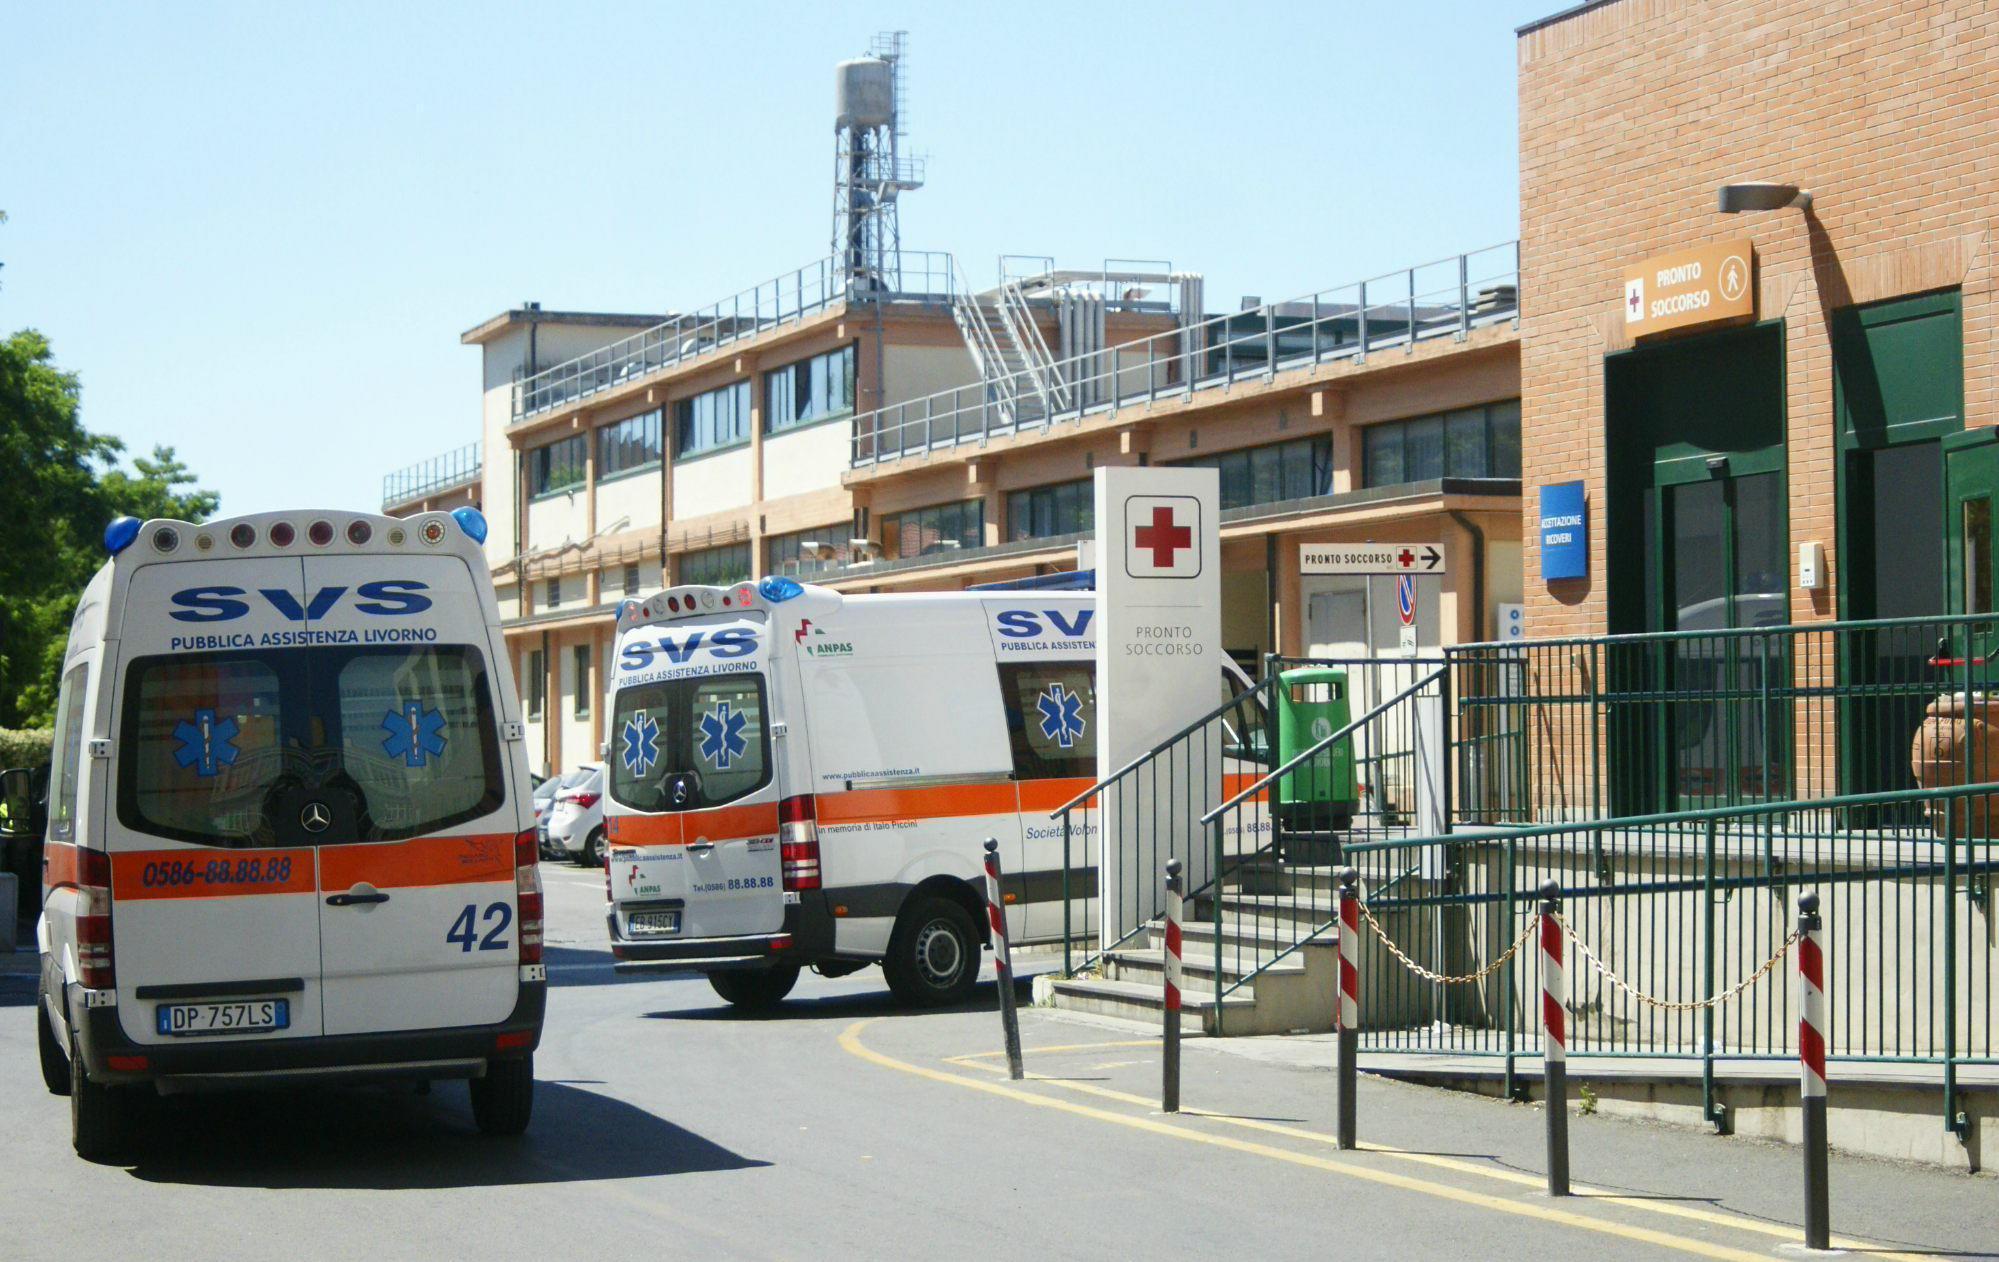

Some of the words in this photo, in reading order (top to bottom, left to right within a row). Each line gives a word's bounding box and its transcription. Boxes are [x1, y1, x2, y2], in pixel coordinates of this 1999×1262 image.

[1656, 262, 1702, 288] PRONTO
[1650, 289, 1710, 318] SOCCORSO
[1305, 553, 1341, 565] PRONTO
[1344, 553, 1393, 565] SOCCORSO
[169, 580, 433, 623] SVS
[171, 632, 255, 651] PUBBLICA
[260, 629, 359, 647] ASSISTENZA
[364, 627, 438, 643] LIVORNO
[1136, 626, 1192, 639] PRONTO
[620, 627, 759, 671] SVS
[817, 642, 853, 653] ANPAS
[1001, 642, 1049, 651] PUBBLICA
[1051, 640, 1096, 650] ASSISTEN
[1126, 643, 1203, 656] SOCCORSO
[619, 673, 655, 688] PUBBLICA
[656, 665, 710, 681] ASSISTENZA
[712, 660, 757, 674] LIVORNO
[822, 767, 920, 781] www.pubblicaassistenza.it
[828, 822, 863, 833] memoria
[864, 820, 872, 831] di
[143, 856, 292, 888] 0586-88.88.88
[639, 884, 661, 894] ANPAS
[728, 876, 774, 890] 88.88.88
[446, 902, 512, 952] 42
[173, 1007, 199, 1029] DP
[208, 1003, 273, 1028] 757LS
